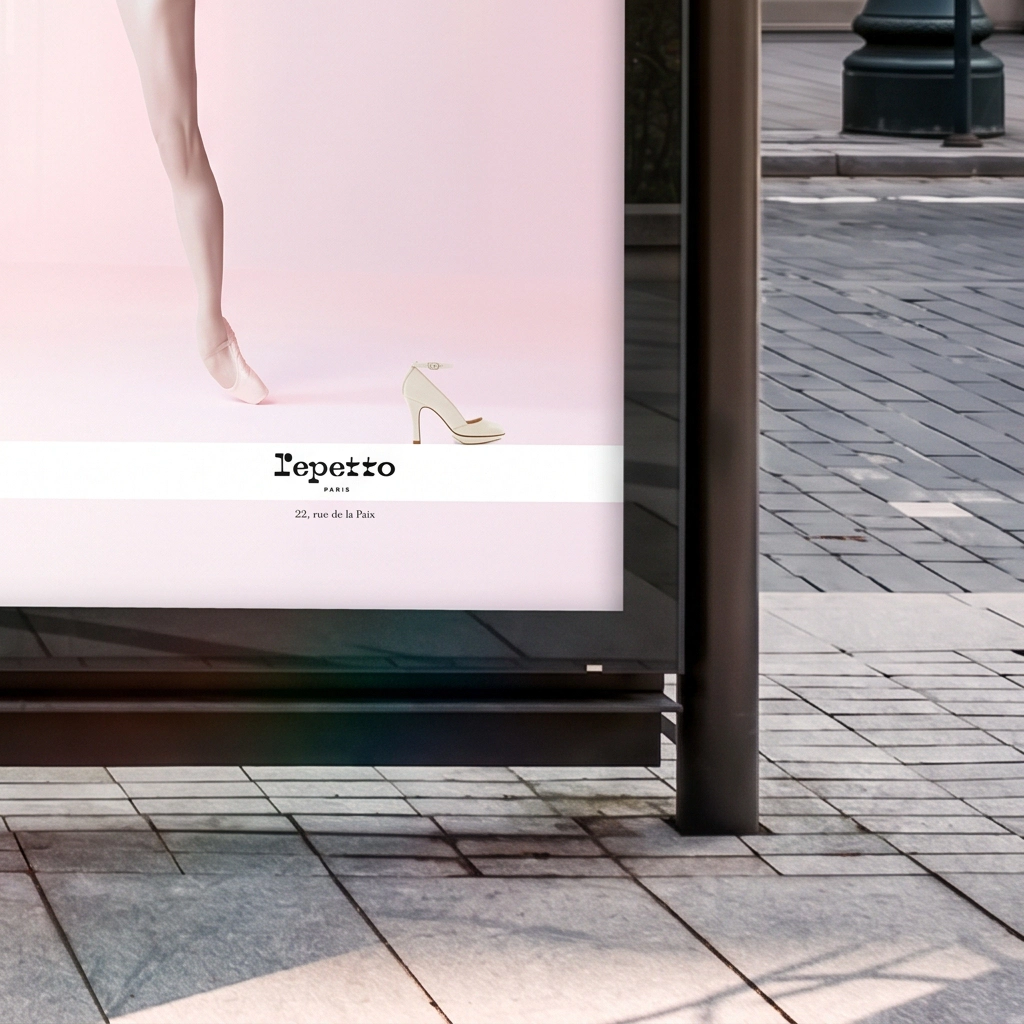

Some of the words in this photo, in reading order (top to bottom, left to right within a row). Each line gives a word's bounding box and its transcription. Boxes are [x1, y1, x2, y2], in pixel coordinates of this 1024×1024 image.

[274, 452, 396, 484] repetto
[294, 509, 311, 520] 22,
[331, 509, 343, 519] de
[345, 509, 354, 519] la
[356, 509, 376, 519] Paix
